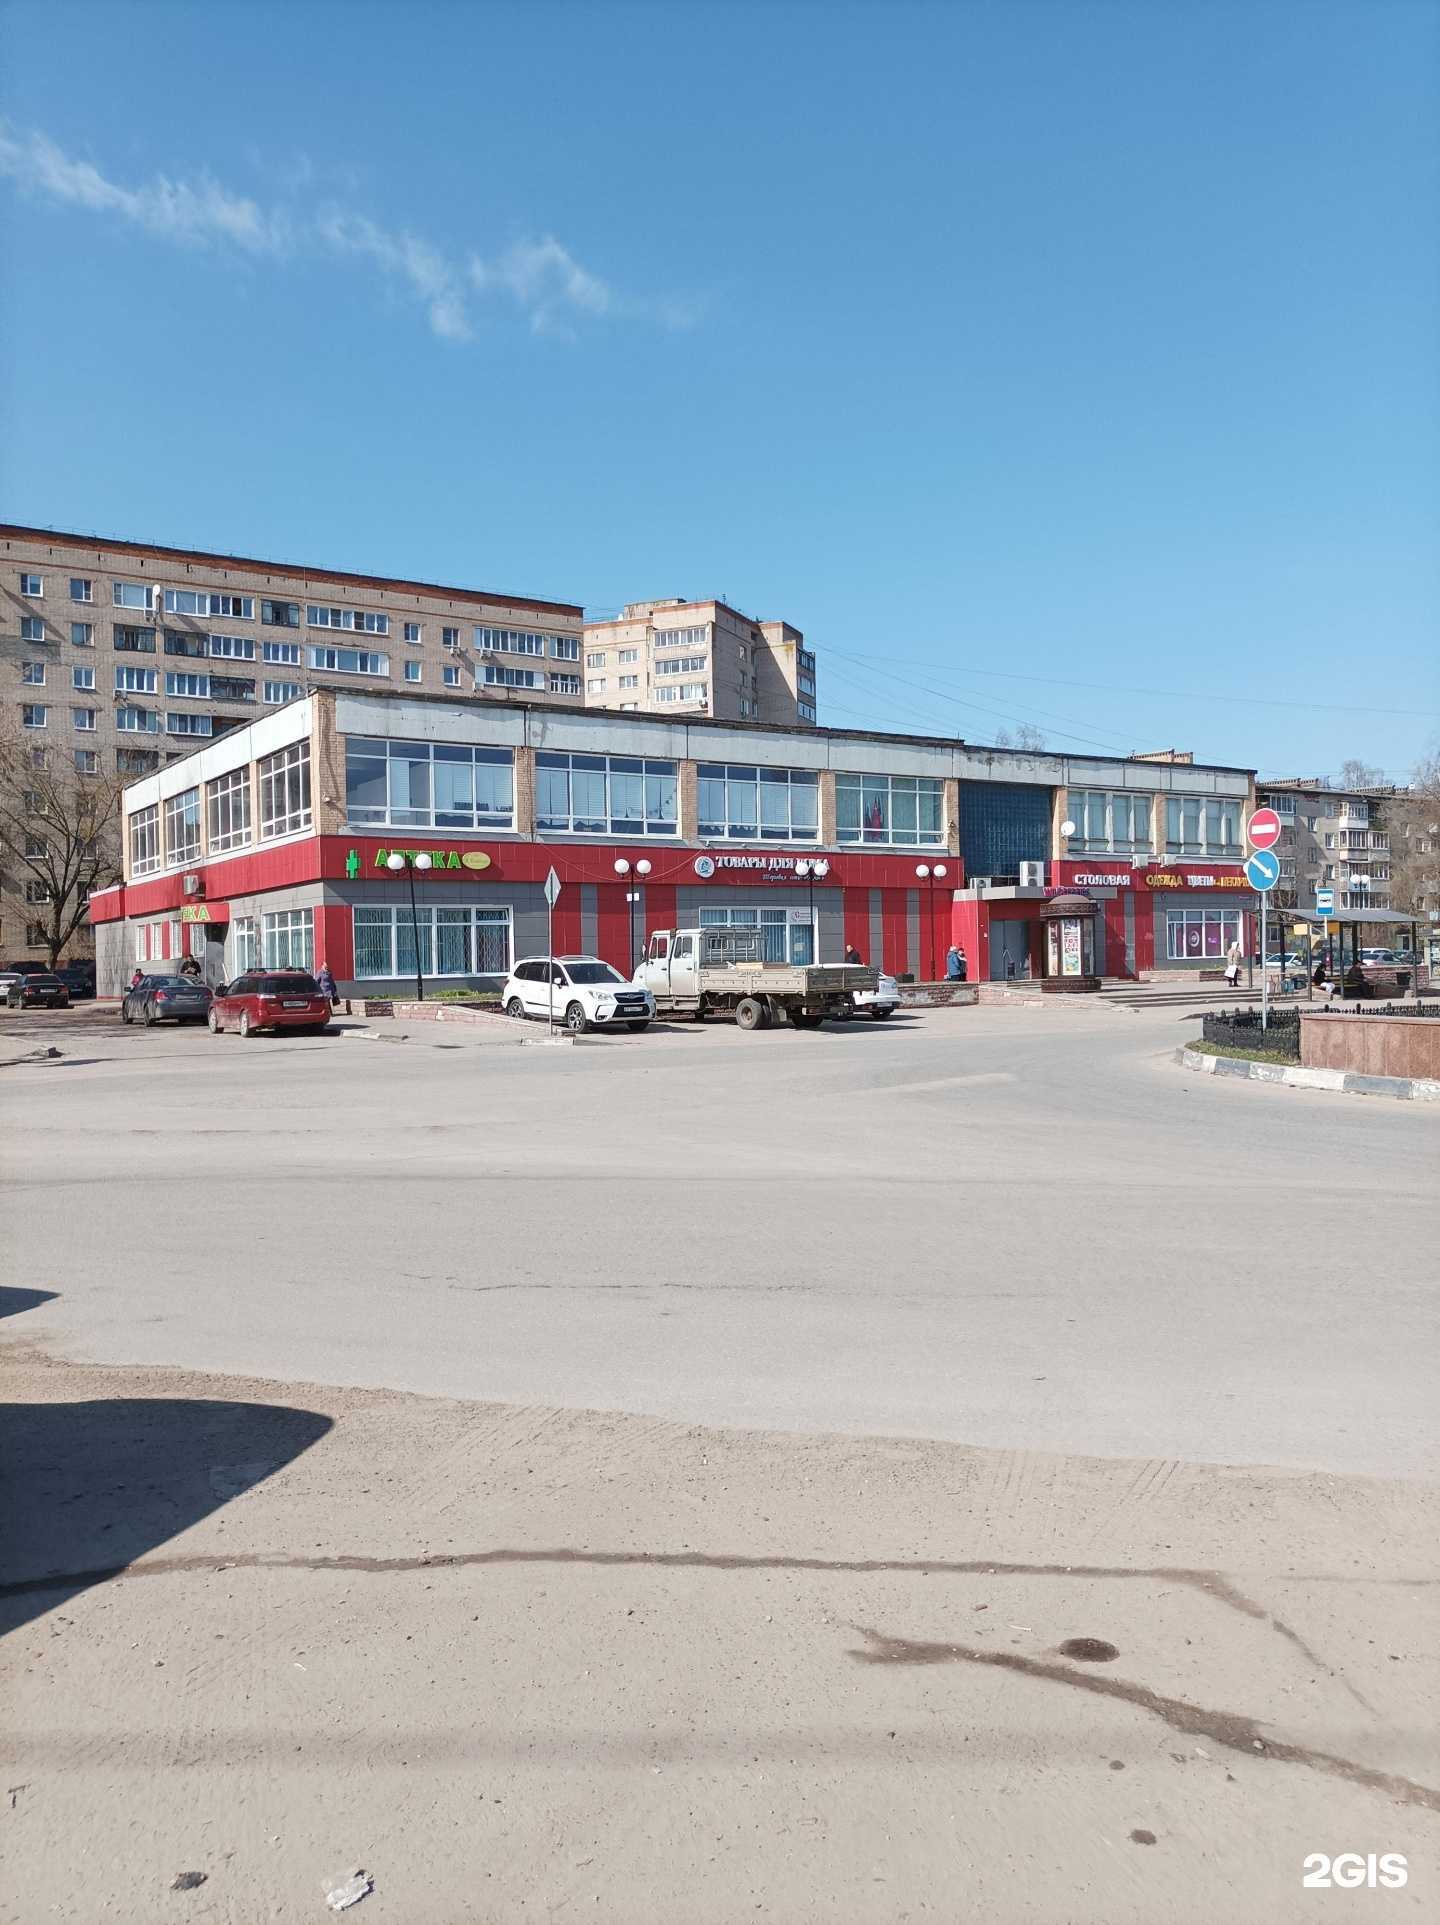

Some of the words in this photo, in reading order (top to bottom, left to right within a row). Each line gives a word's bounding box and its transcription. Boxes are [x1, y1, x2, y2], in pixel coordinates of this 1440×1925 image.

[375, 849, 461, 868] АПТКА
[715, 856, 766, 869] ТОВАРЫ
[768, 857, 794, 871] ДЛЯ
[1074, 874, 1131, 886] СТОЛОВАЯ
[1146, 874, 1183, 888] ОДЕЖДА
